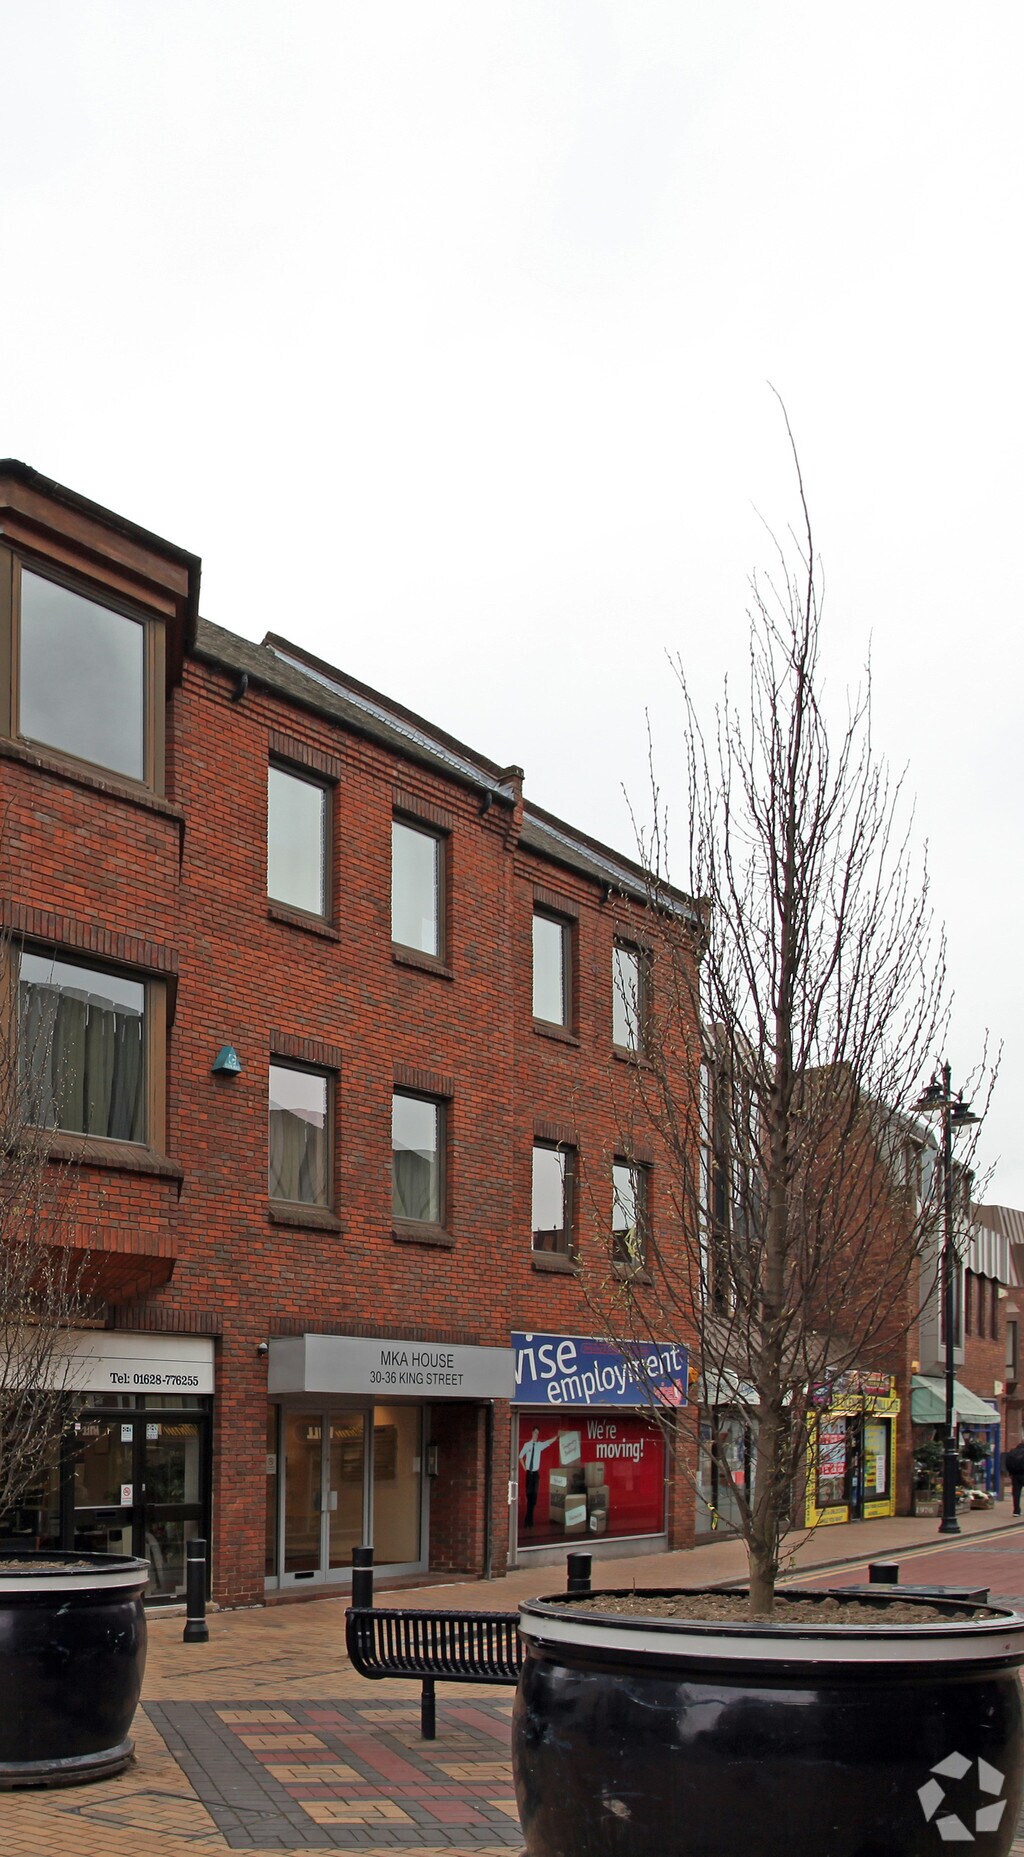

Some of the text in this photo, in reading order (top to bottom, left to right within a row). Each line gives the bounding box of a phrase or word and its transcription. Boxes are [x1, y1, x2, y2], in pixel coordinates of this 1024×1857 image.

[380, 1350, 454, 1369] MKA HOUSE
[110, 1372, 199, 1386] Tel: 01628-776255
[370, 1371, 463, 1386] 30-36 KING STREET
[547, 1346, 682, 1404] employment
[587, 1420, 616, 1439] We're
[596, 1438, 644, 1462] moving!
